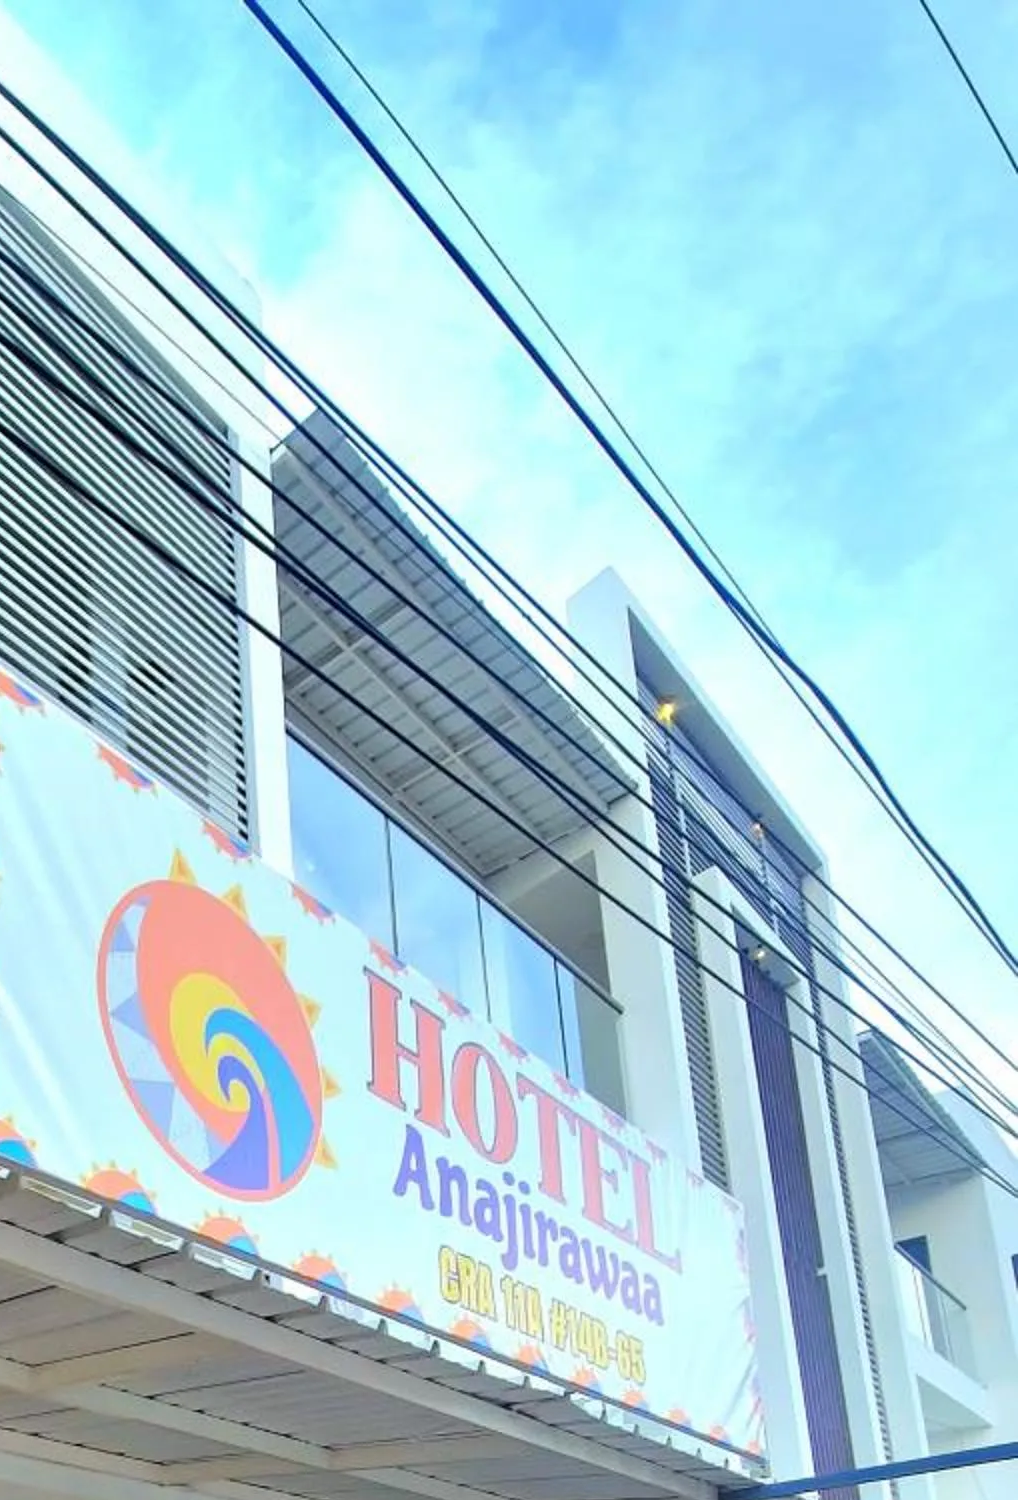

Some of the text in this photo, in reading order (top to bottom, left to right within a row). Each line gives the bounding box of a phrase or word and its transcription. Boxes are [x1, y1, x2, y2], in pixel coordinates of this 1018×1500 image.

[364, 966, 682, 1274] HOTEL
[393, 1124, 664, 1326] Anajirawaa
[438, 1244, 647, 1387] CRA 11A #14B-65
